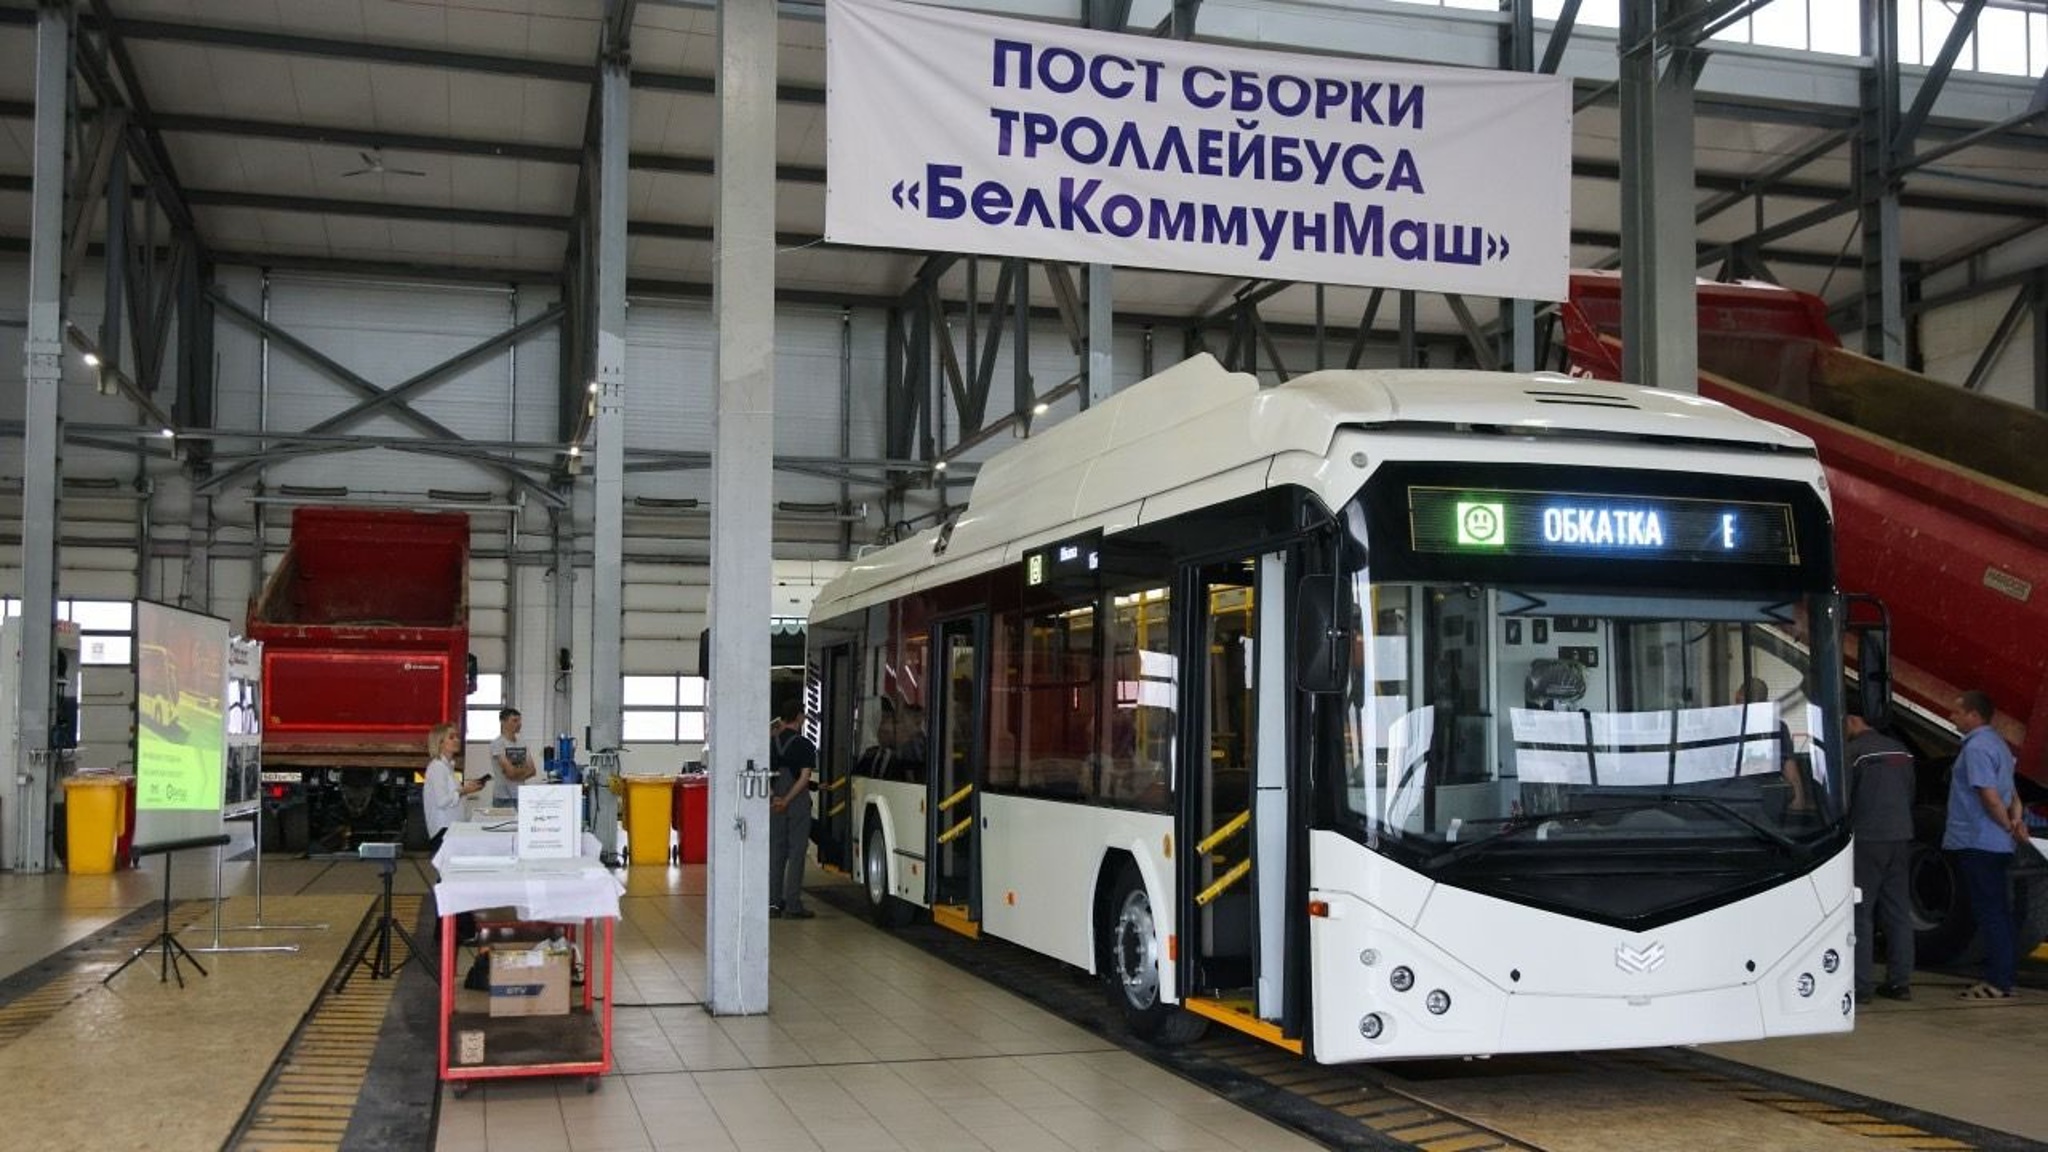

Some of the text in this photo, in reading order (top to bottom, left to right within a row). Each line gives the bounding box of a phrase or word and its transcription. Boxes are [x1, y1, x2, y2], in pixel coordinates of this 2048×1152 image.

[991, 39, 1425, 129] ПОСТ СБОРКИ
[989, 107, 1425, 195] ТРОЛЛЕЙБУСА
[891, 163, 1511, 266] «БелКоммунМаш»
[1543, 507, 1664, 546] ОБКАТКА
